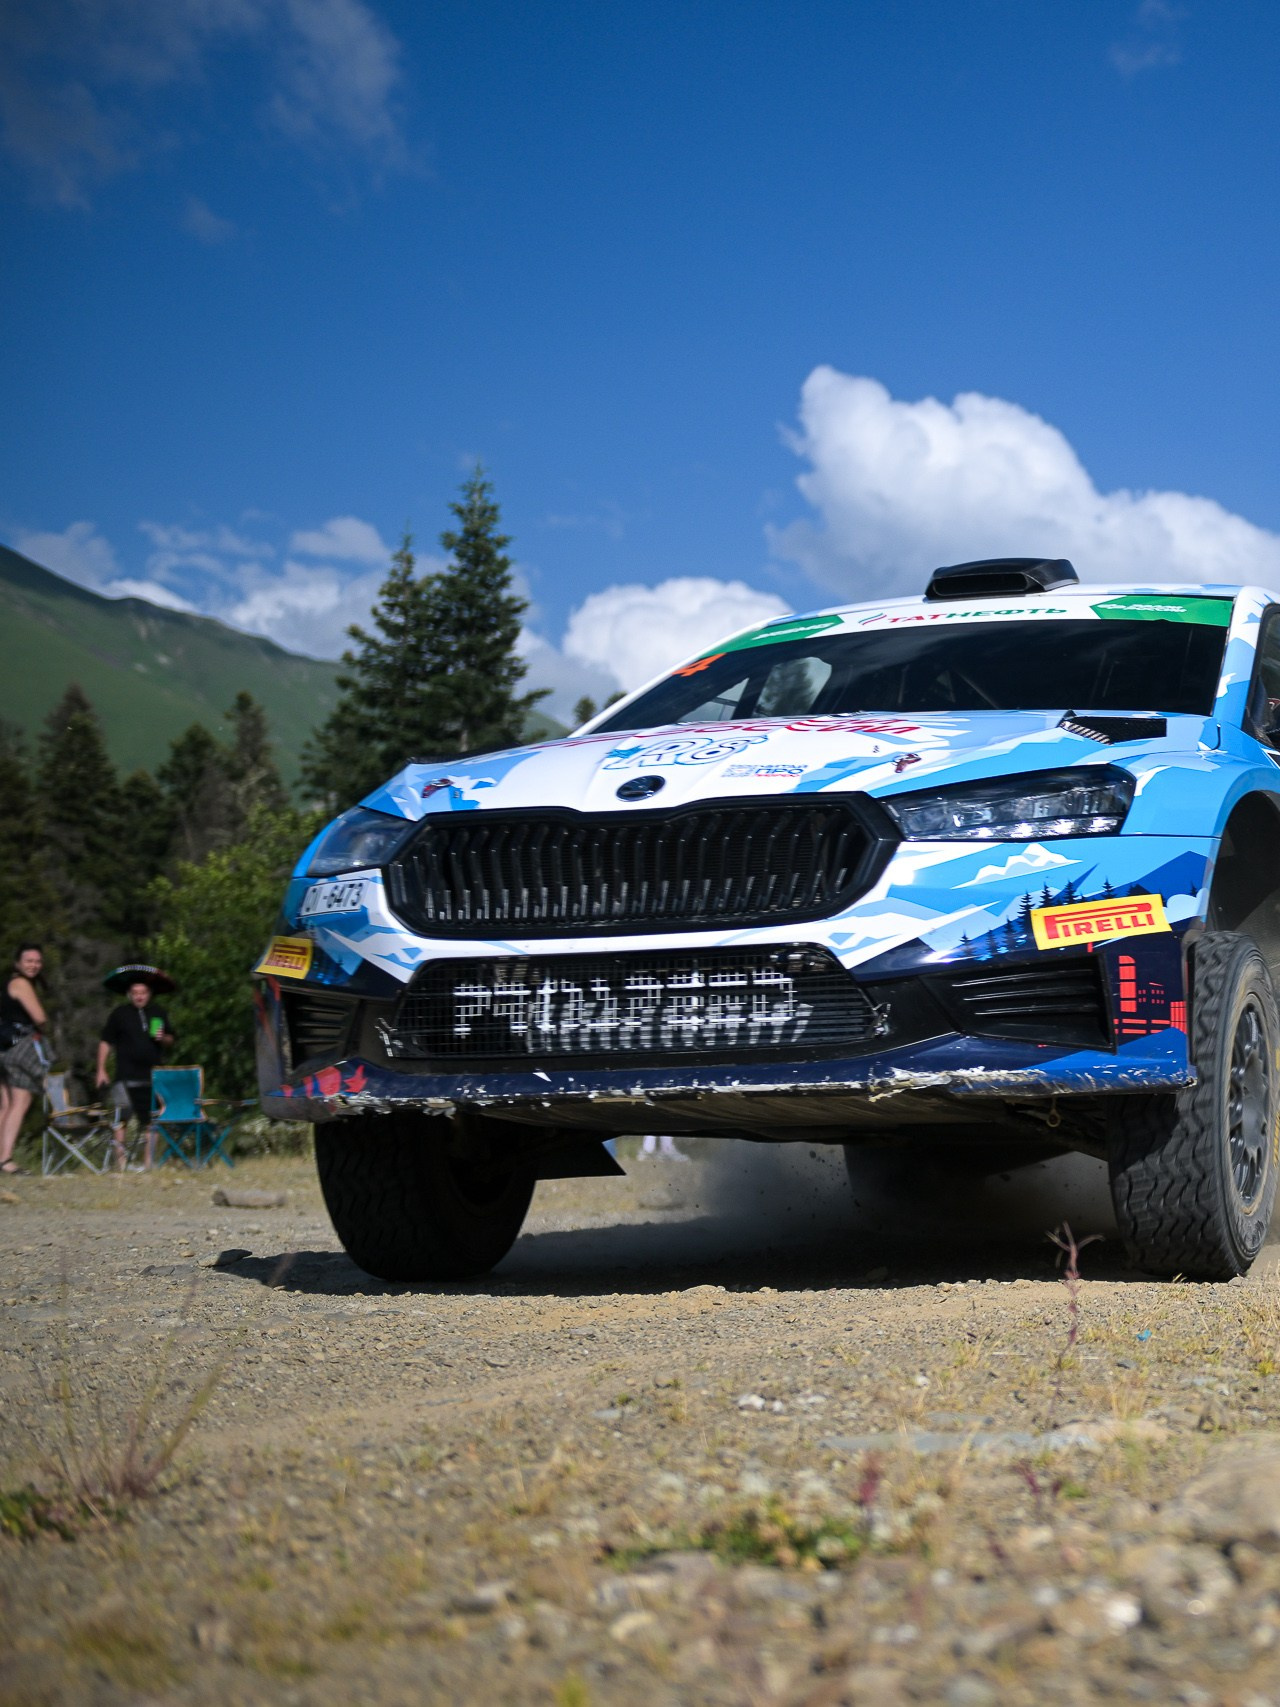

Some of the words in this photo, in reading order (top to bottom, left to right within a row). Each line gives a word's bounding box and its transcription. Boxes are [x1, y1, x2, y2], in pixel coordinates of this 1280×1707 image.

[888, 608, 1067, 624] ТАТНЕФТЬ
[1043, 902, 1156, 940] PIRELLI
[264, 944, 309, 971] PIRELLI
